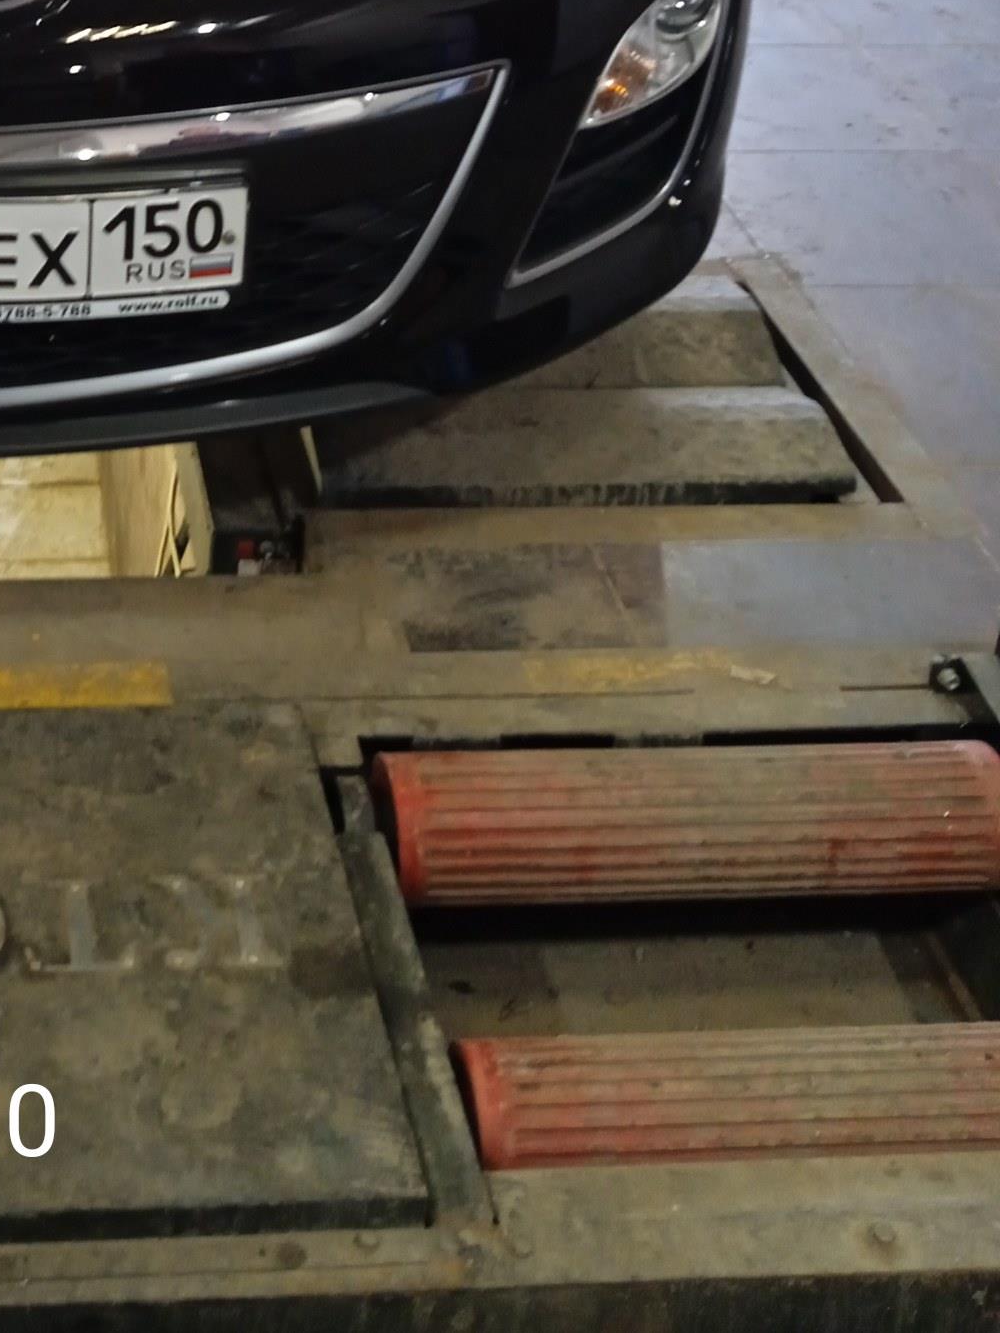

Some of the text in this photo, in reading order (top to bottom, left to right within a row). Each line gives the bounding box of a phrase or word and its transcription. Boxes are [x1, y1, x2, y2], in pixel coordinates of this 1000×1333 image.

[103, 199, 224, 260] 150
[126, 261, 186, 285] RUS
[118, 294, 220, 314] www.rolf.ru
